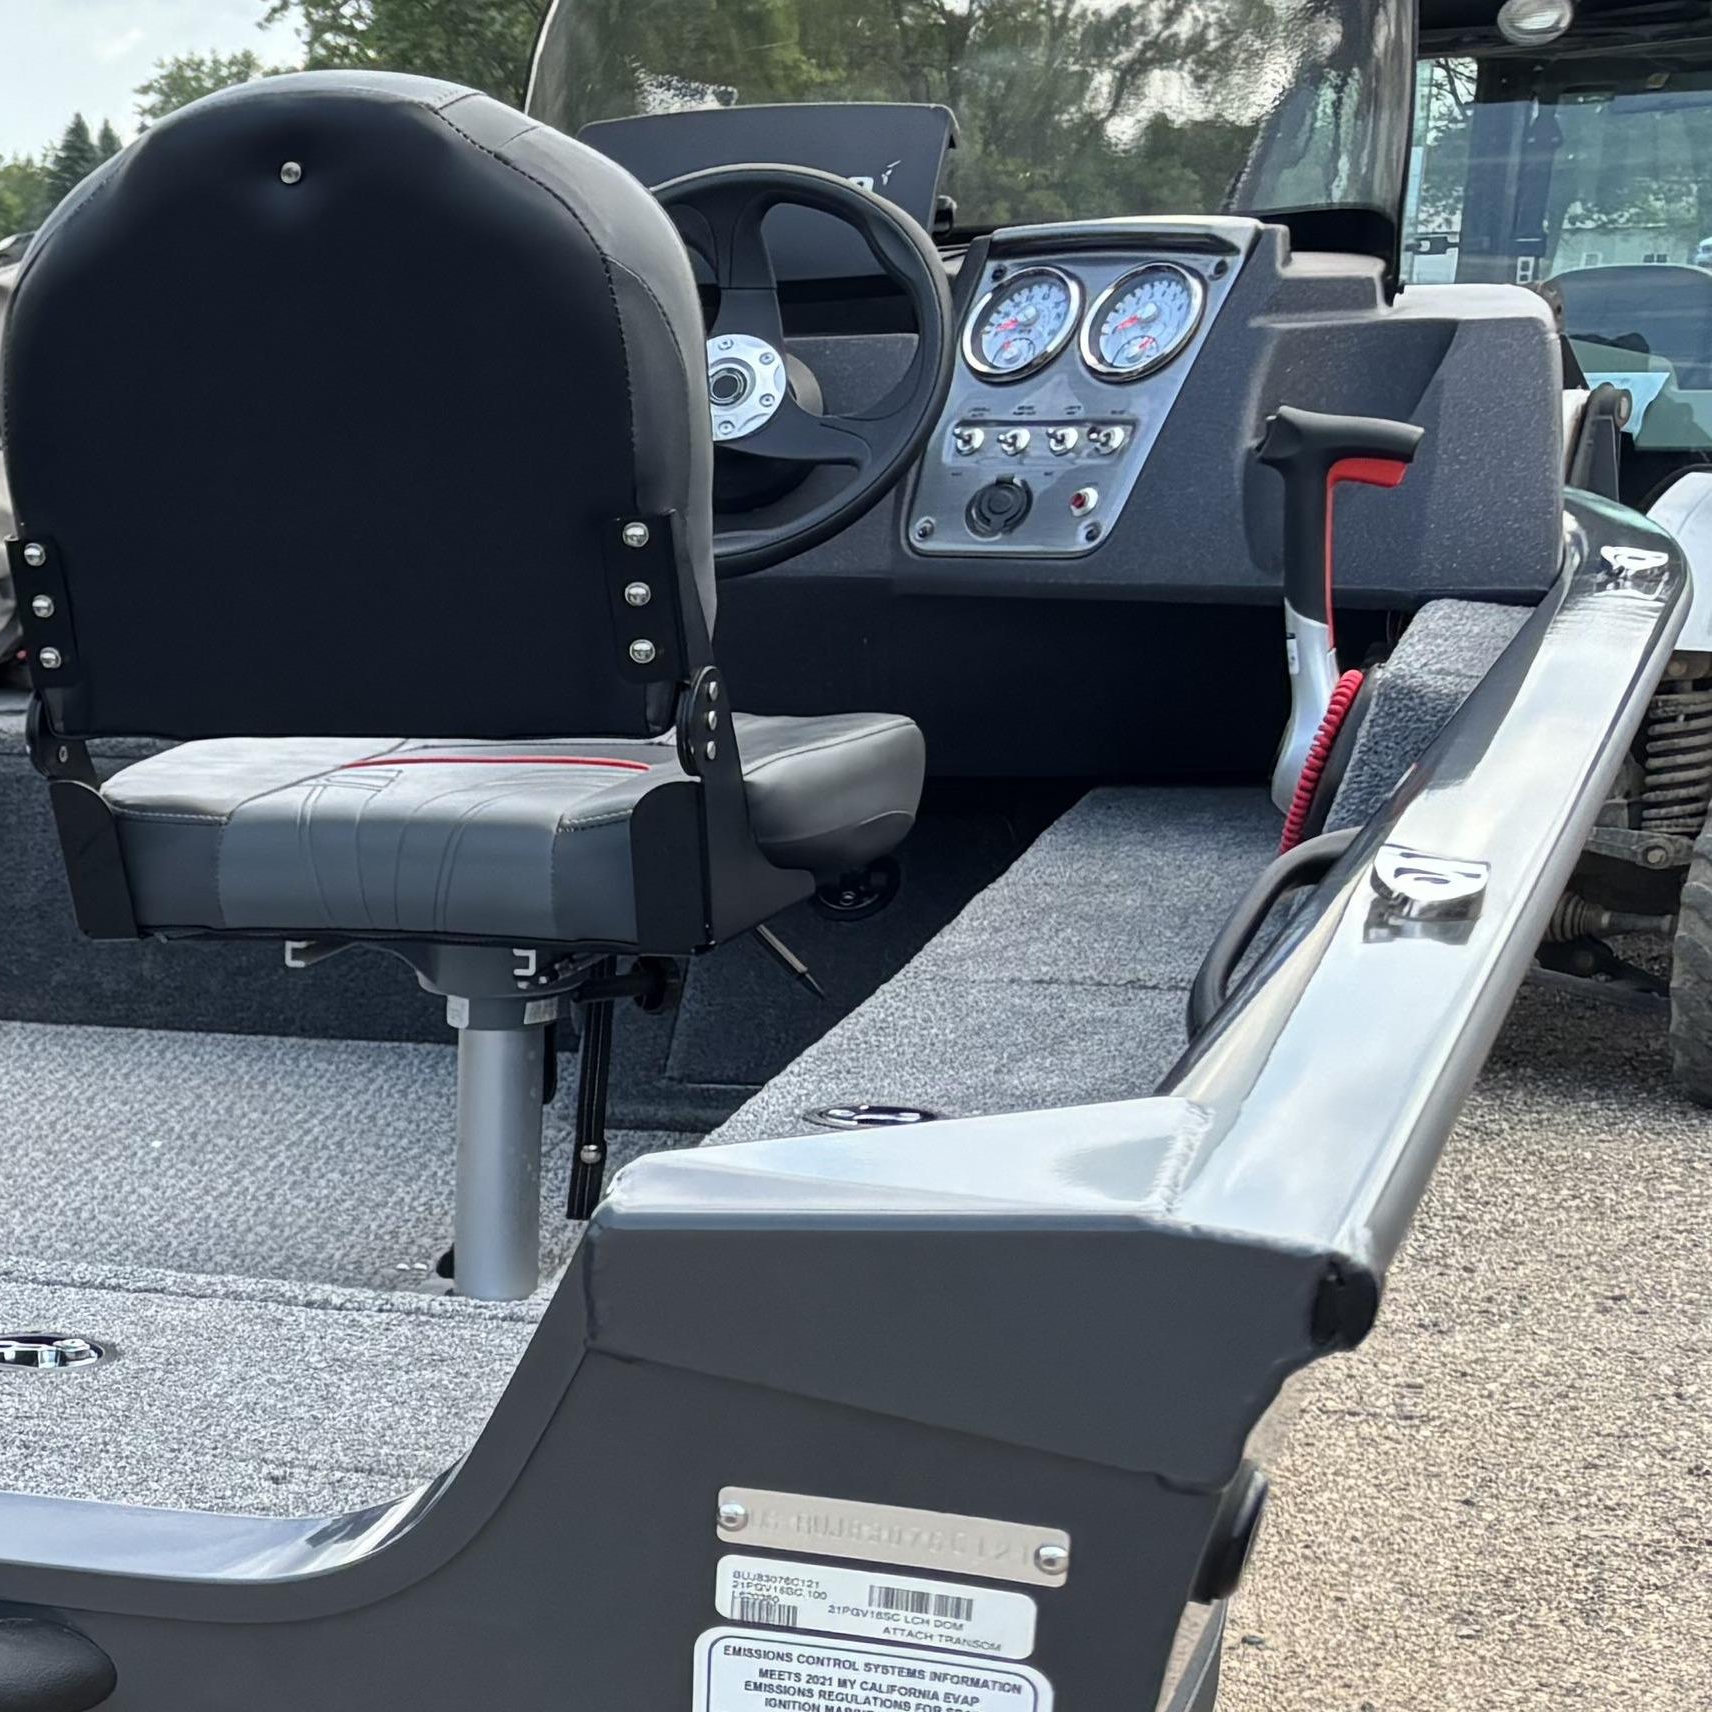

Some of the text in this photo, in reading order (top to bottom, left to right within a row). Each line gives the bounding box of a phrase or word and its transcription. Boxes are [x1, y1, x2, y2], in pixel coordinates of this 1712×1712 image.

[882, 1627, 1003, 1652] ATTACH TRANSOM
[724, 1645, 1022, 1695] EMISSIONS CONTROL SYSTEMS INFORMATION
[759, 1668, 980, 1707] MEETS 2021 MY CALIFORNIA EVAP
[744, 1680, 814, 1698] EMISSIONS
[818, 1689, 911, 1712] REGULATIONS
